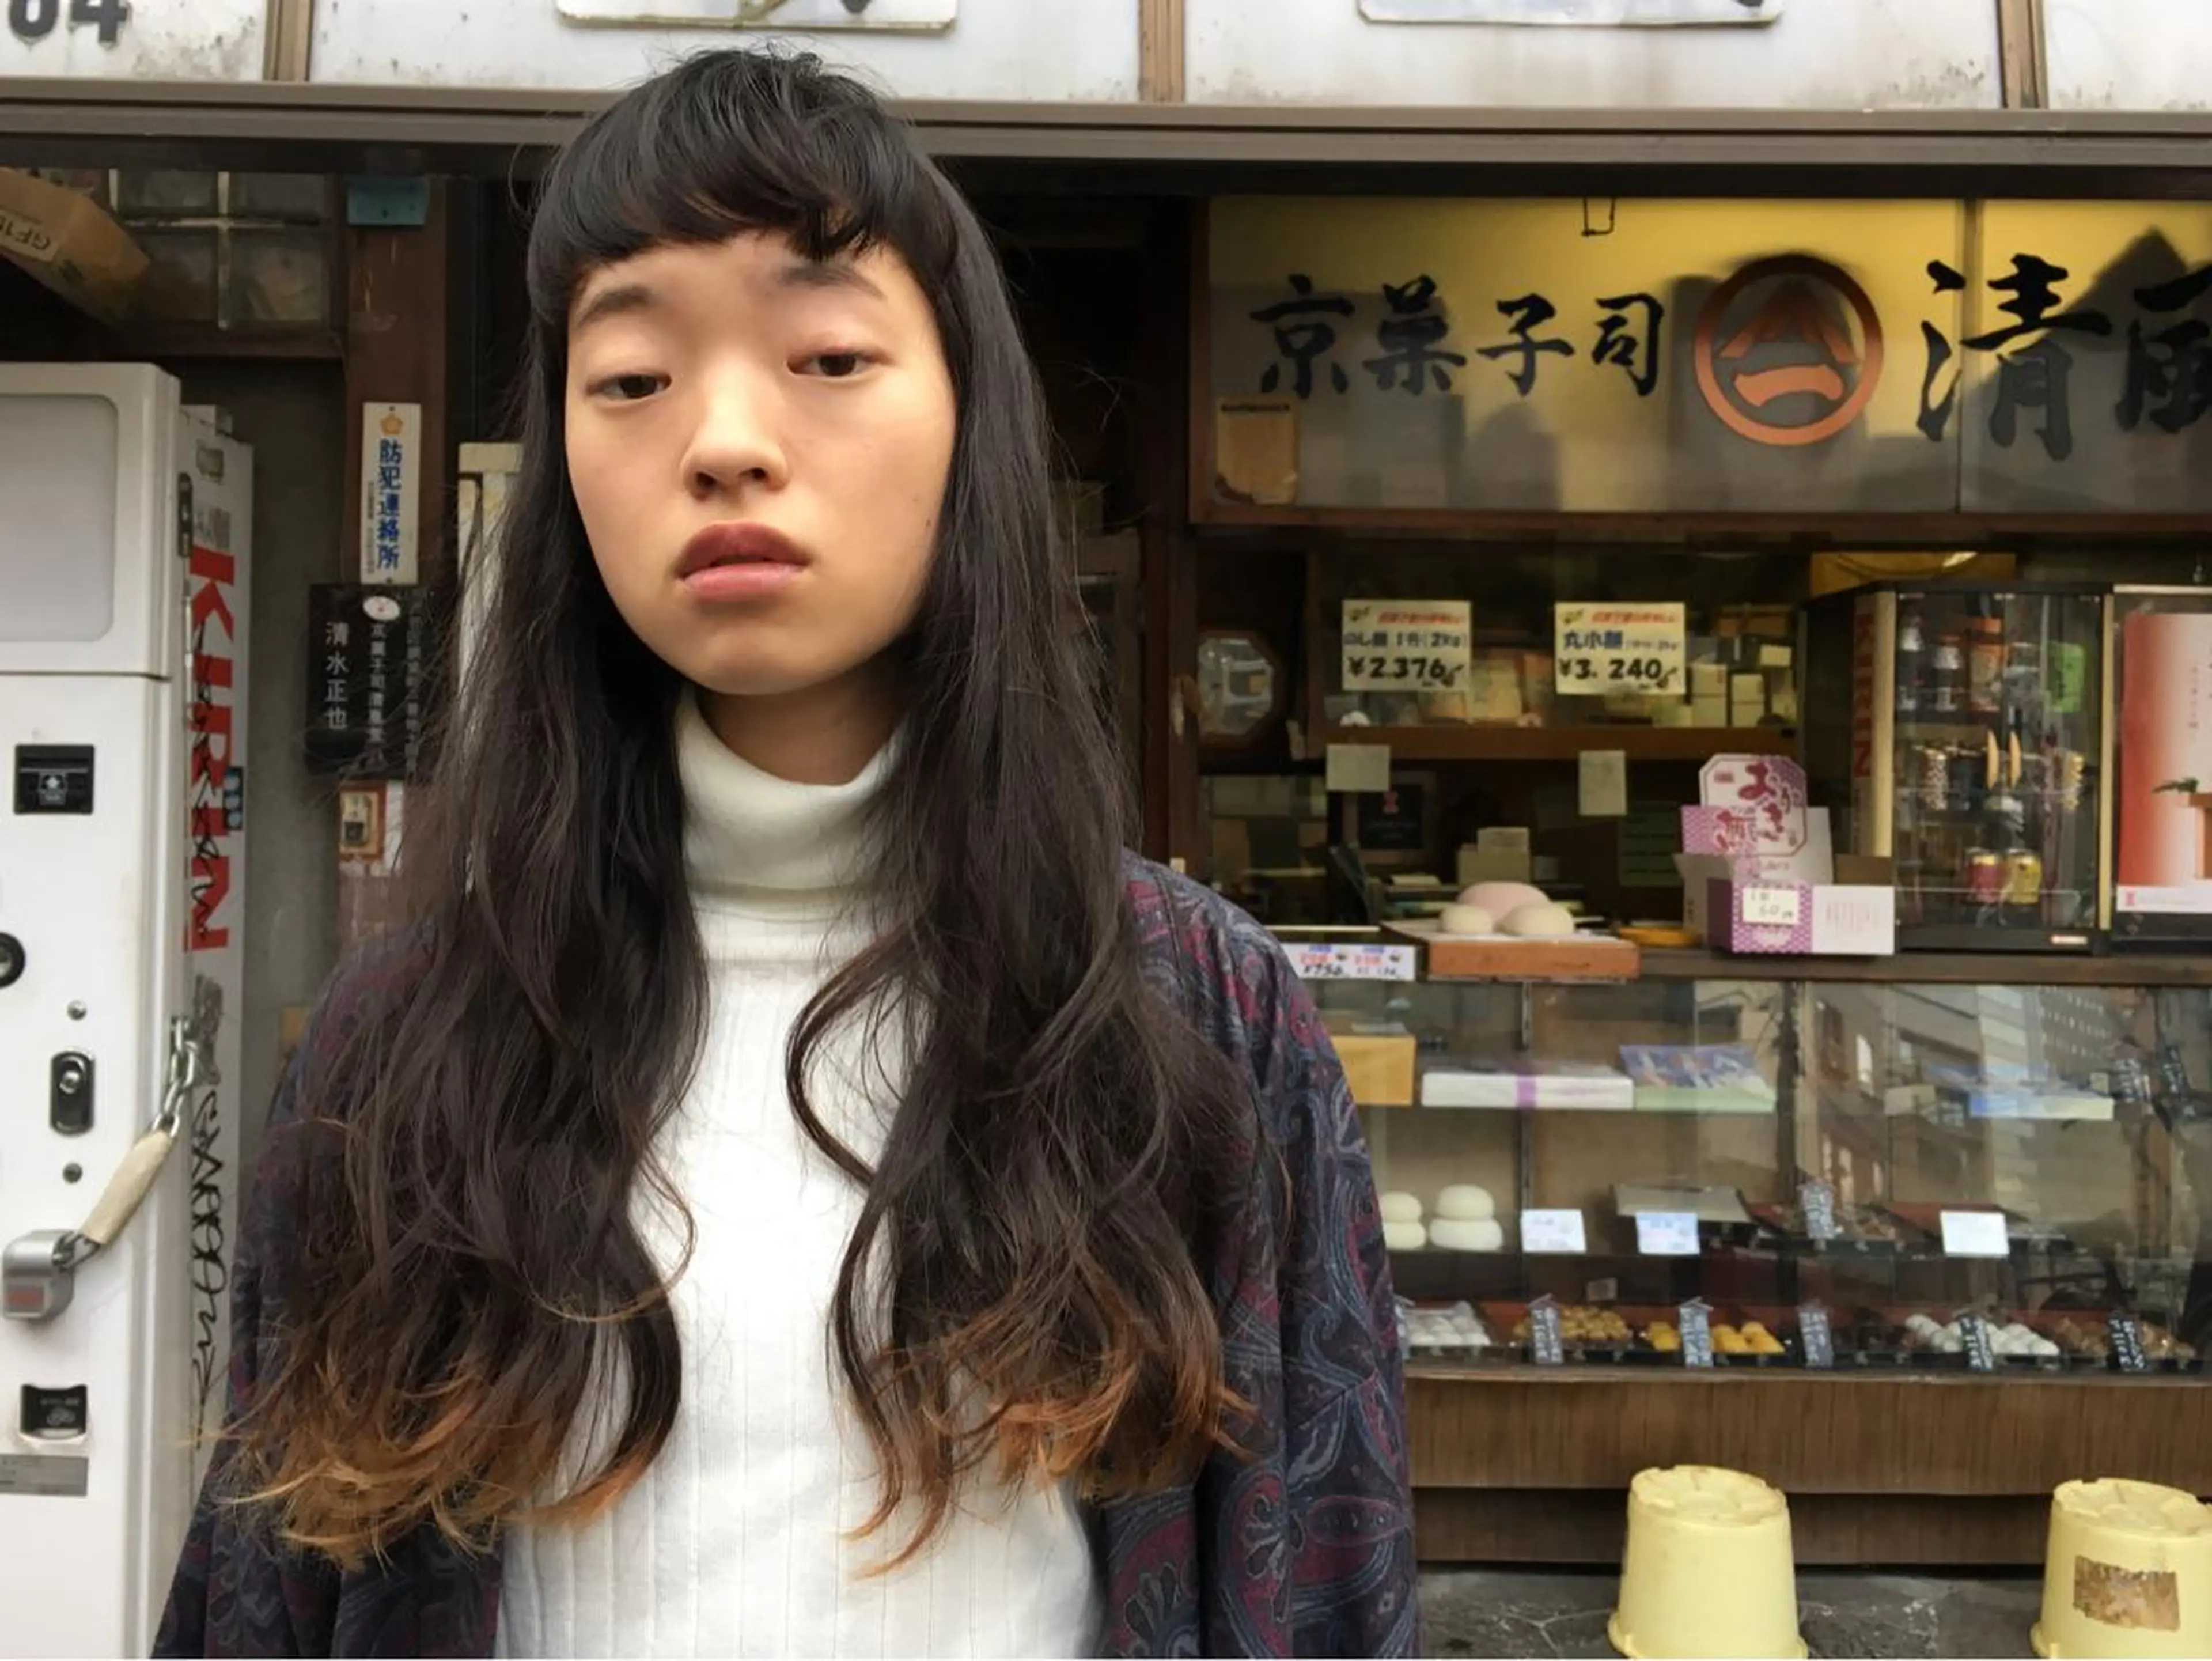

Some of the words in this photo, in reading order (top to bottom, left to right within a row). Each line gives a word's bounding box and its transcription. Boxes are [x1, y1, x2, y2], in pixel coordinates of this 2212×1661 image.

[1249, 274, 1664, 399] 京菓子司
[188, 544, 235, 952] KIRIN
